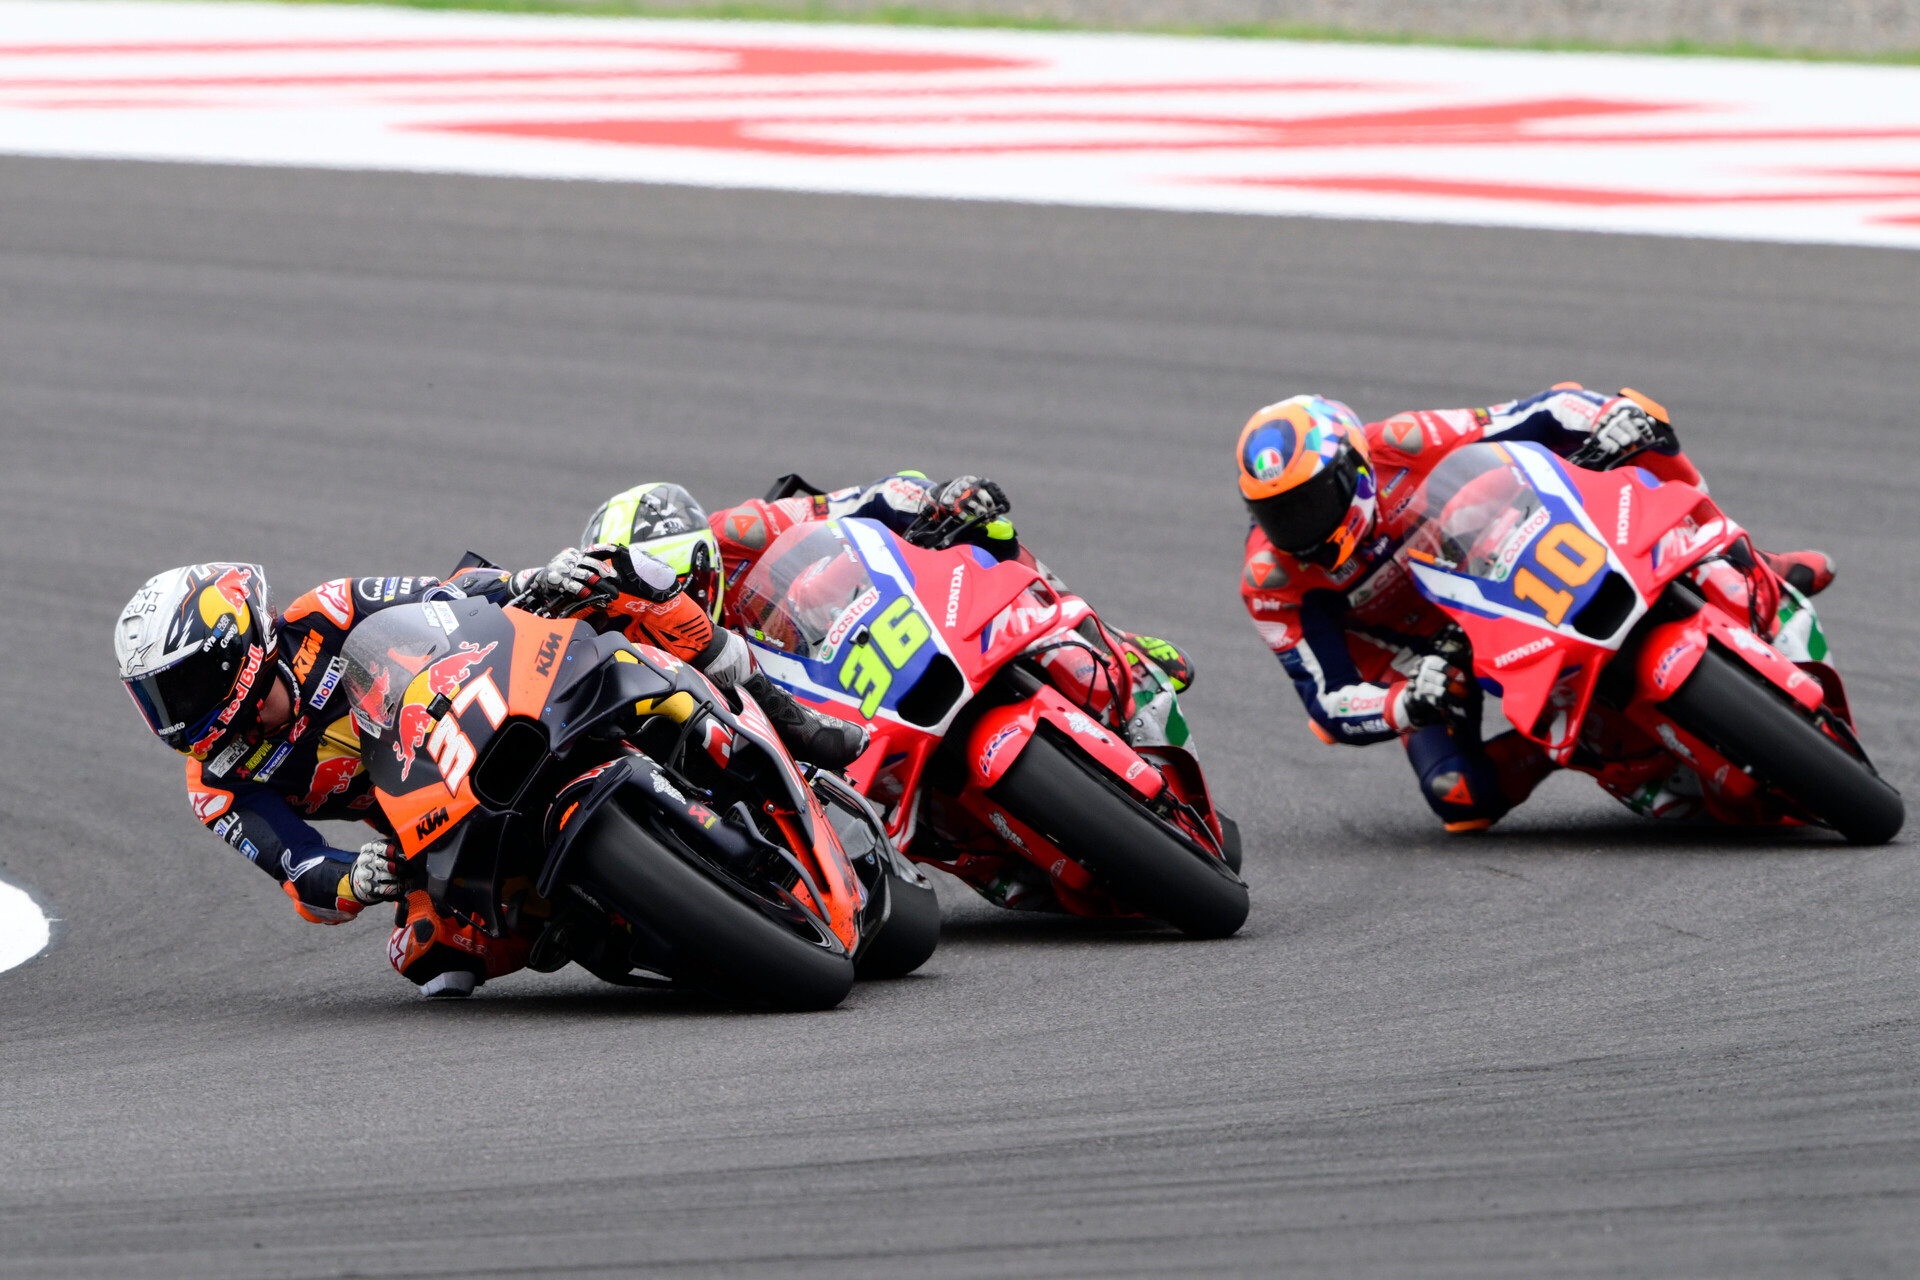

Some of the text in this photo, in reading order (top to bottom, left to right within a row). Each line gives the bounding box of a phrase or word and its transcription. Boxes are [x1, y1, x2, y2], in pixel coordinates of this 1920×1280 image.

[1503, 510, 1549, 563] Castrol
[1616, 484, 1632, 545] HONDA
[945, 563, 965, 628] HONDA
[1513, 522, 1607, 628] 10
[829, 590, 878, 645] Castrol
[292, 628, 324, 685] KTM
[535, 632, 563, 677] KTM
[838, 594, 931, 720] 36
[1493, 636, 1555, 668] HONDA
[217, 642, 264, 725] Red Bull
[311, 672, 339, 707] Mobil
[425, 666, 510, 798] 37
[416, 806, 449, 841] KTM
